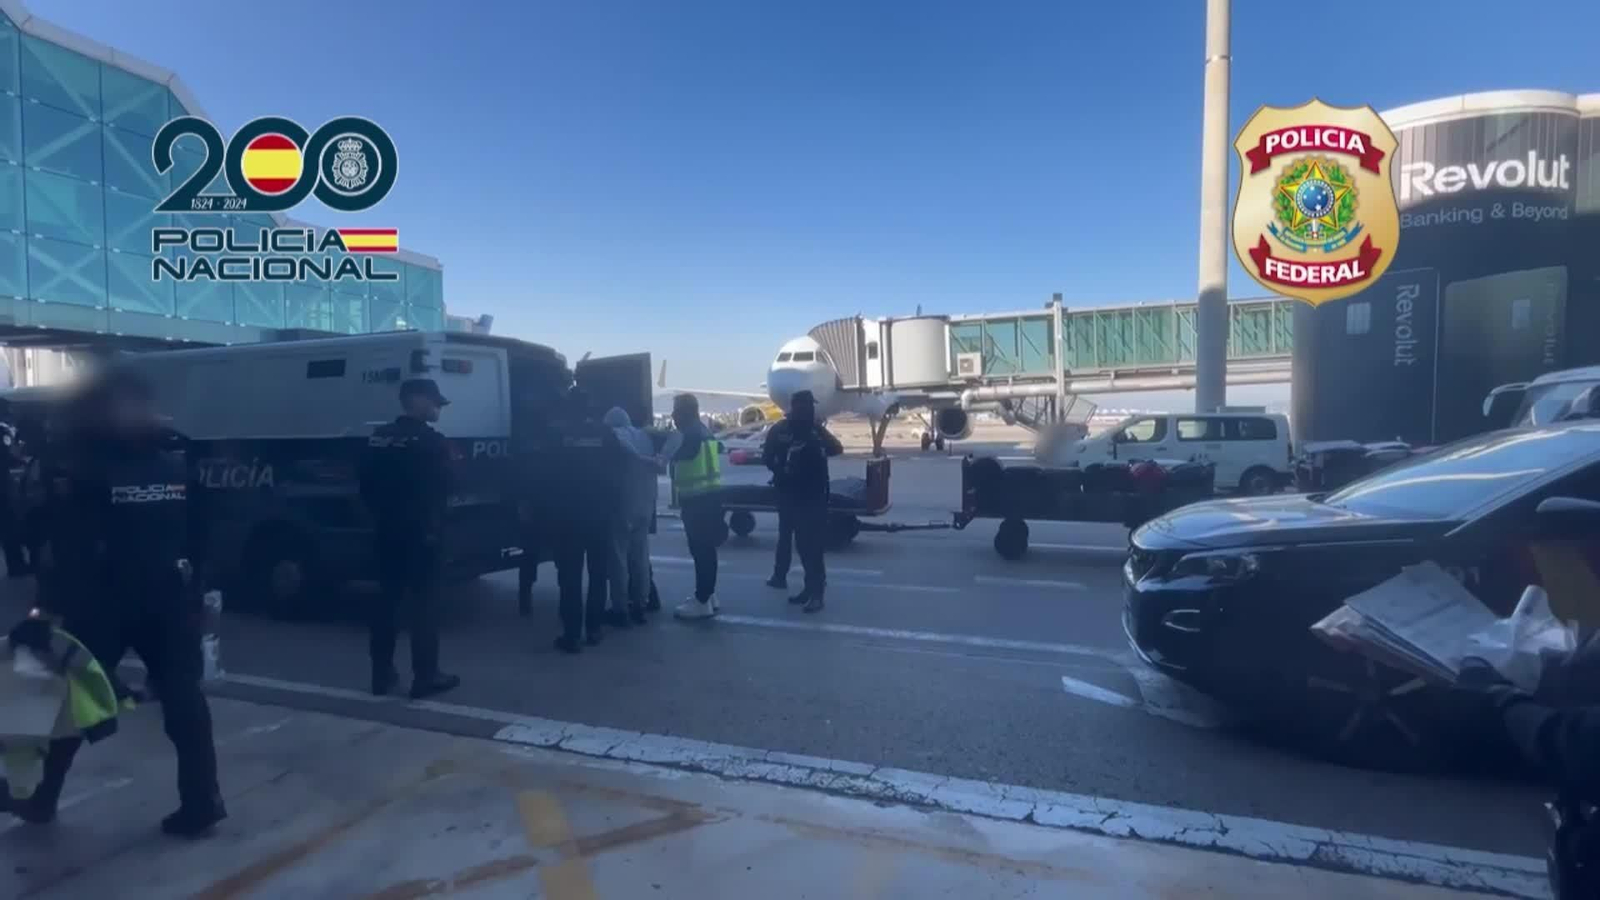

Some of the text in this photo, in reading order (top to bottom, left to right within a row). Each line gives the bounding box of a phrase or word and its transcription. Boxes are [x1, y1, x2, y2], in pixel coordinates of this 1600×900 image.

[1400, 150, 1571, 200] Revolut
[1399, 201, 1568, 229] Banking & Beyond
[1393, 283, 1421, 366] Revolut
